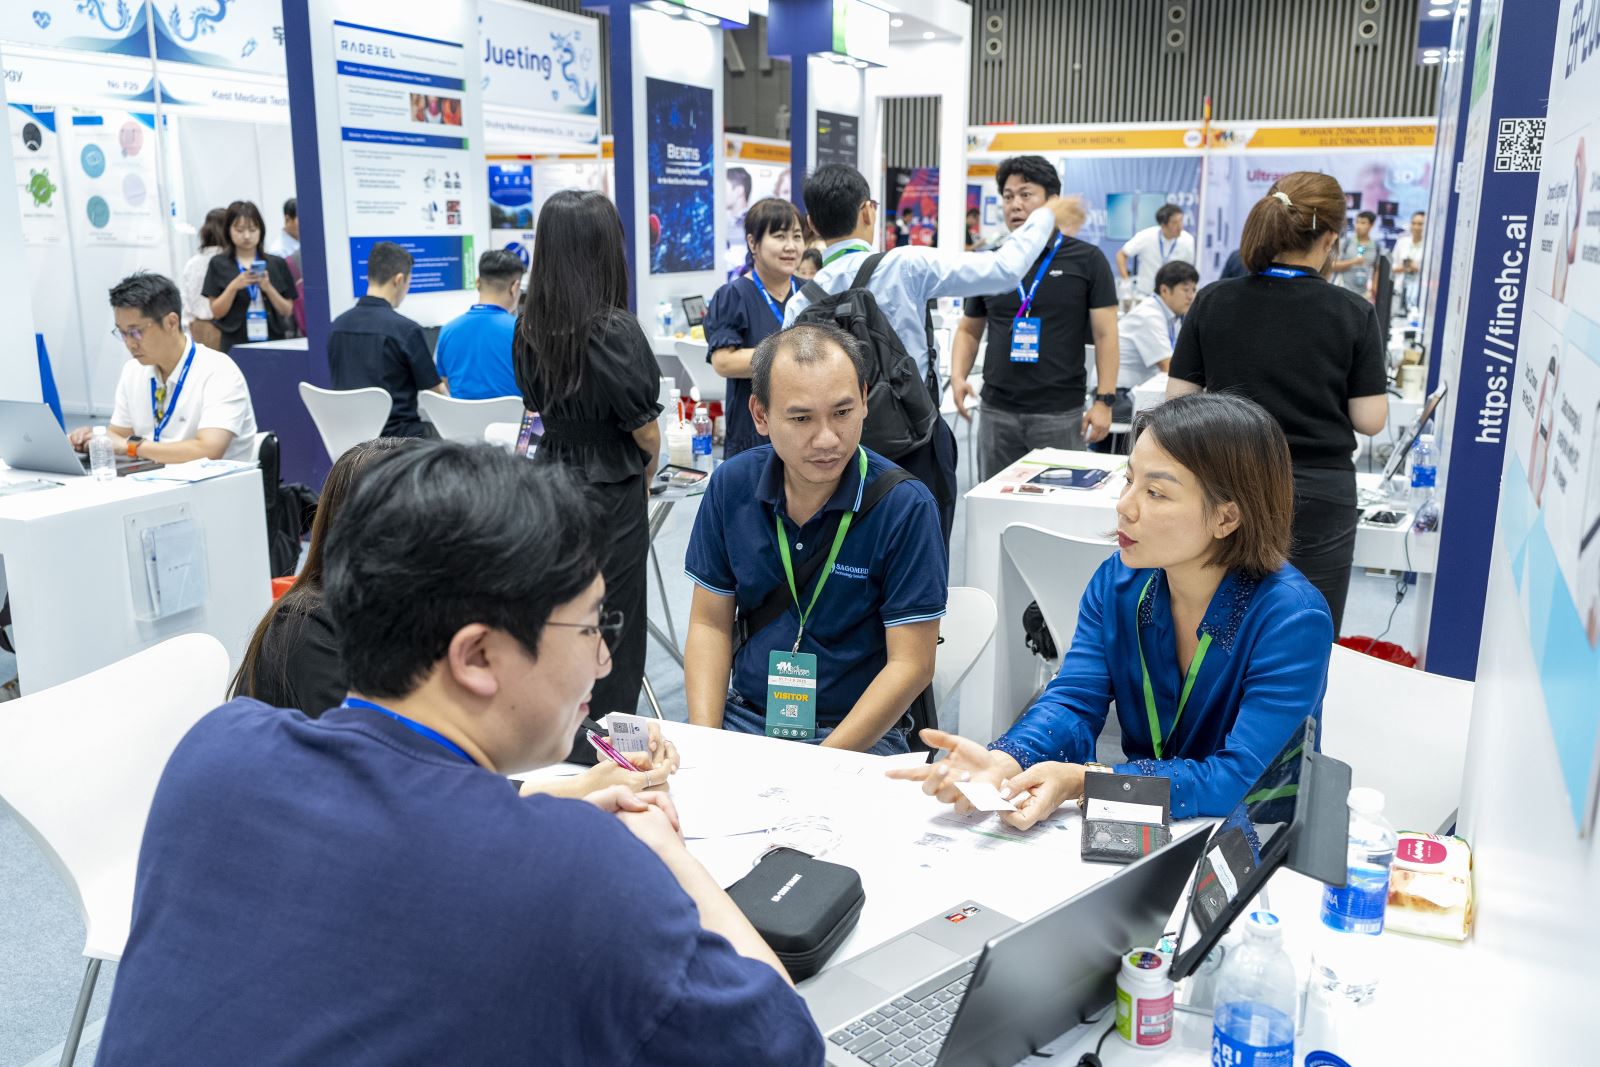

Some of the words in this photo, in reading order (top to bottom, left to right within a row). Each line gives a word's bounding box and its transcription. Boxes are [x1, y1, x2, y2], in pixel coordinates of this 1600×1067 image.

[340, 39, 396, 59] RADEXEL
[484, 38, 552, 80] Jueting
[234, 92, 268, 105] Medical
[1475, 214, 1528, 444] https://finehc.ai
[773, 691, 809, 702] VISITOR
